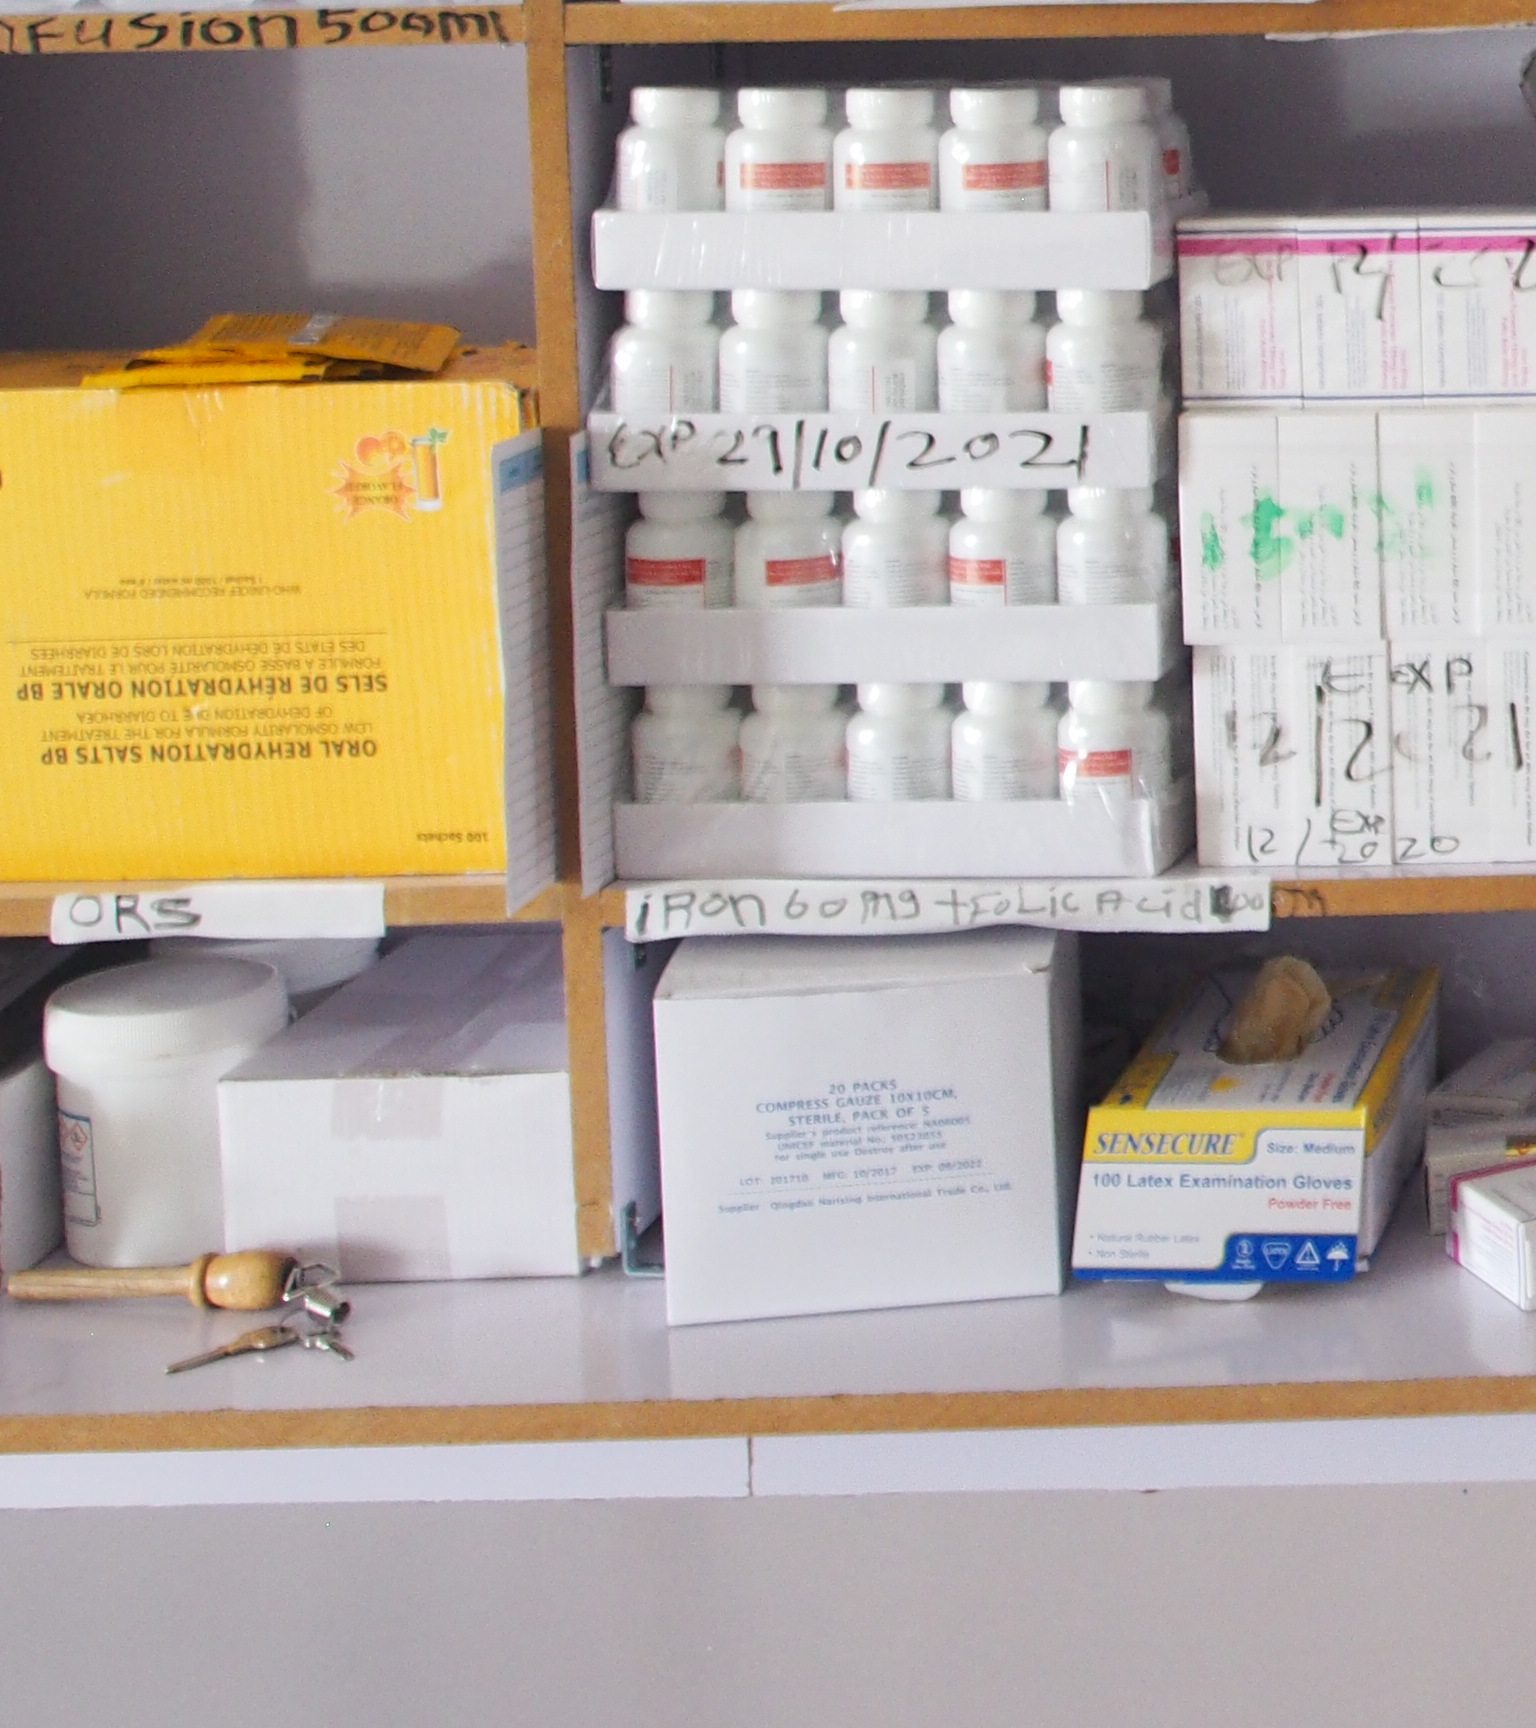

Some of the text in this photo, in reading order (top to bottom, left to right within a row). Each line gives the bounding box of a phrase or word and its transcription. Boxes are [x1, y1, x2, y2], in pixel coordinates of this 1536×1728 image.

[17, 675, 388, 701] SELS DE RÉHYDRATION ORALE BP
[41, 739, 377, 765] ORAL REHYDRATION SALTS BP
[68, 895, 201, 932] ORS
[829, 1079, 897, 1095] 20 PACKS
[756, 1097, 829, 1113] COMPRESS
[836, 1094, 881, 1108] GAUZE
[852, 1109, 888, 1122] PACK
[896, 1107, 913, 1119] OF
[922, 1106, 929, 1116] 5
[1093, 1133, 1234, 1156] SENSECURE
[1267, 1142, 1355, 1154] Size: Medium
[1093, 1174, 1352, 1190] 100 Latex Examination Gloves
[1268, 1198, 1351, 1210] Powder Free
